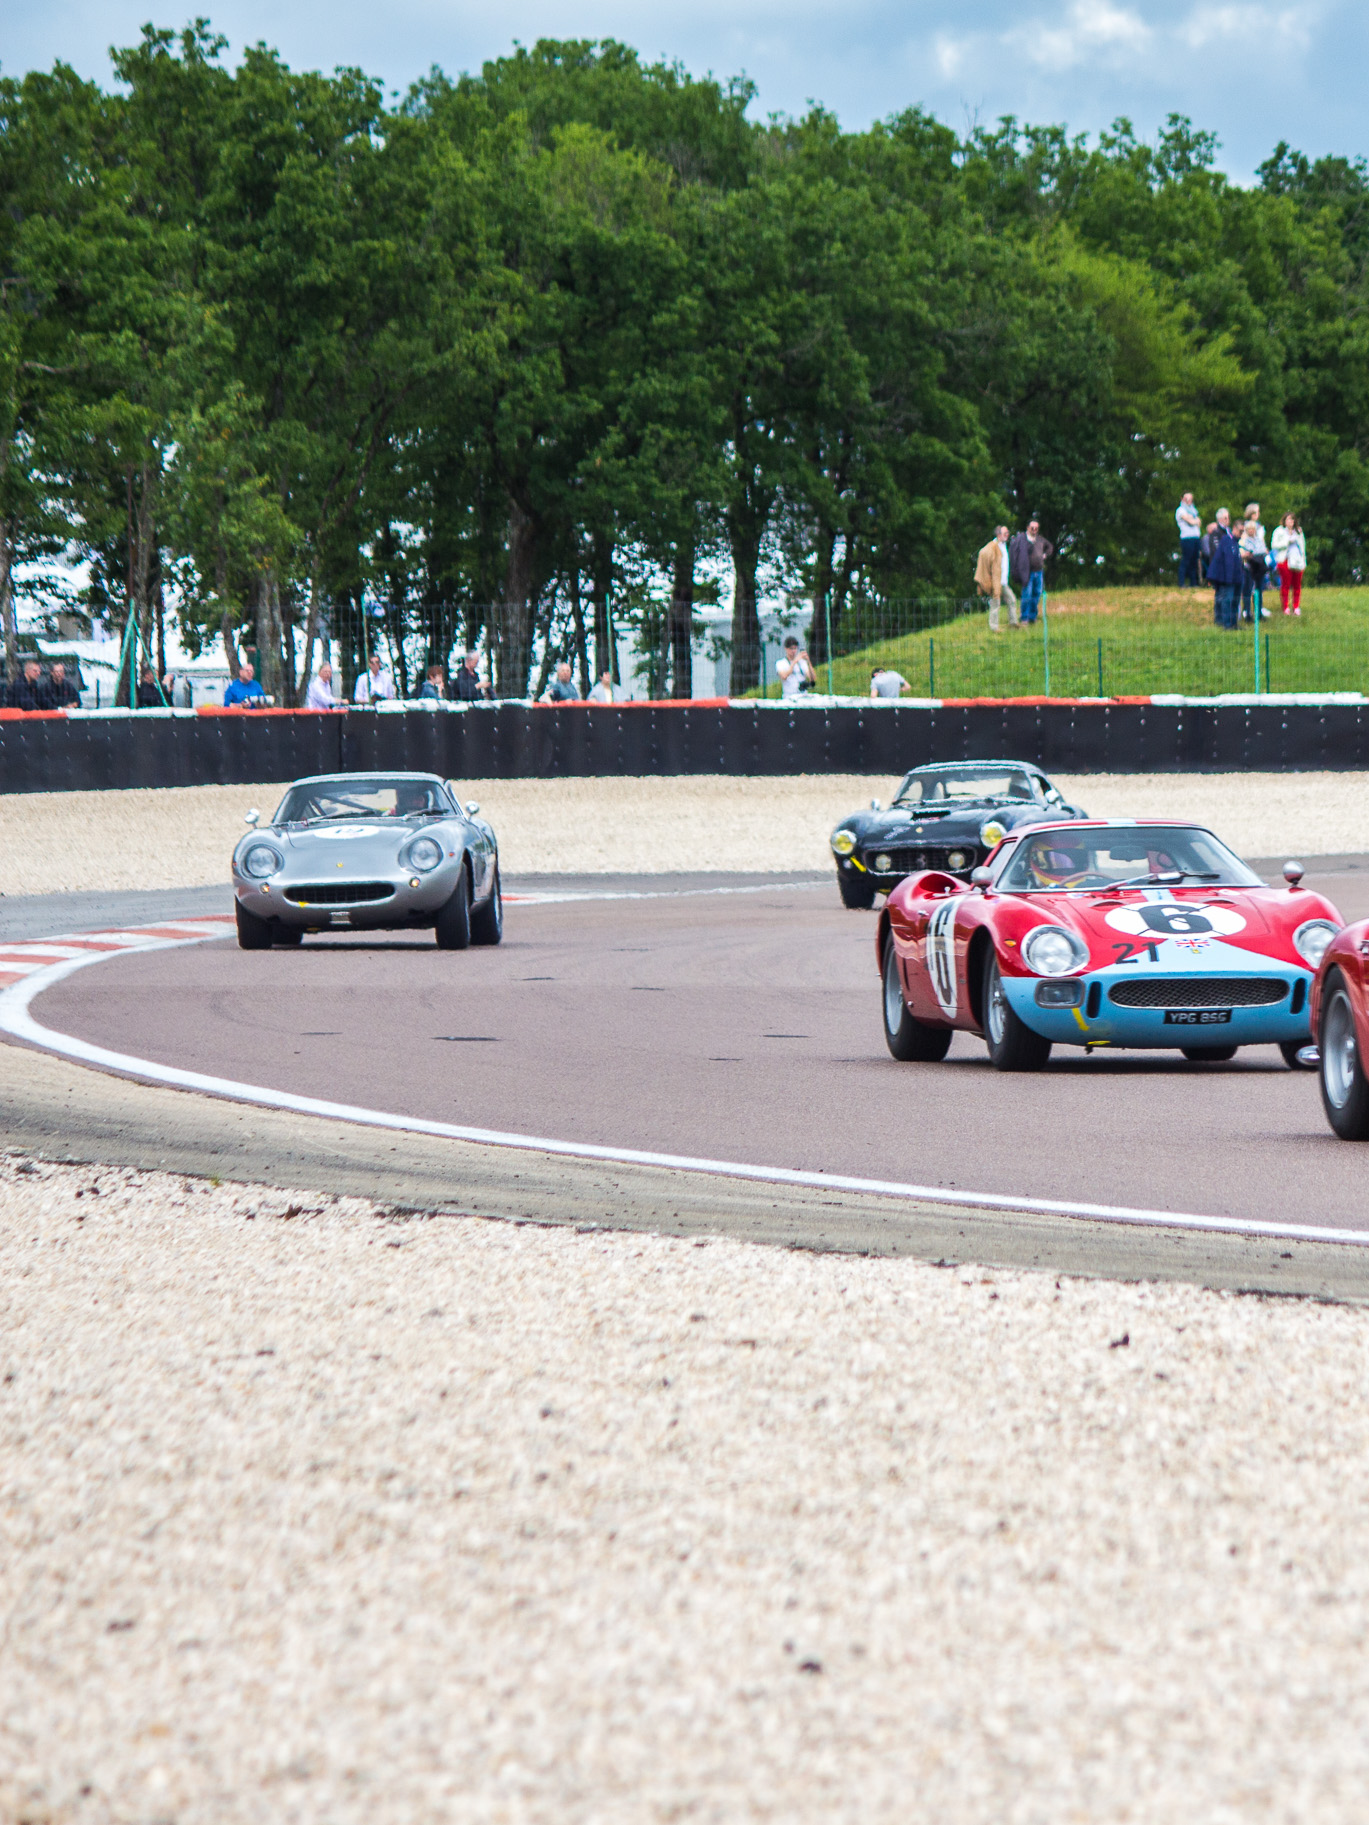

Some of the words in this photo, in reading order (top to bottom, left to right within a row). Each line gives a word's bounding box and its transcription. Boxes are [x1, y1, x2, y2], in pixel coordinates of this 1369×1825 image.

[1138, 904, 1213, 934] 6
[1112, 941, 1160, 964] 21
[1170, 1012, 1197, 1023] YPG
